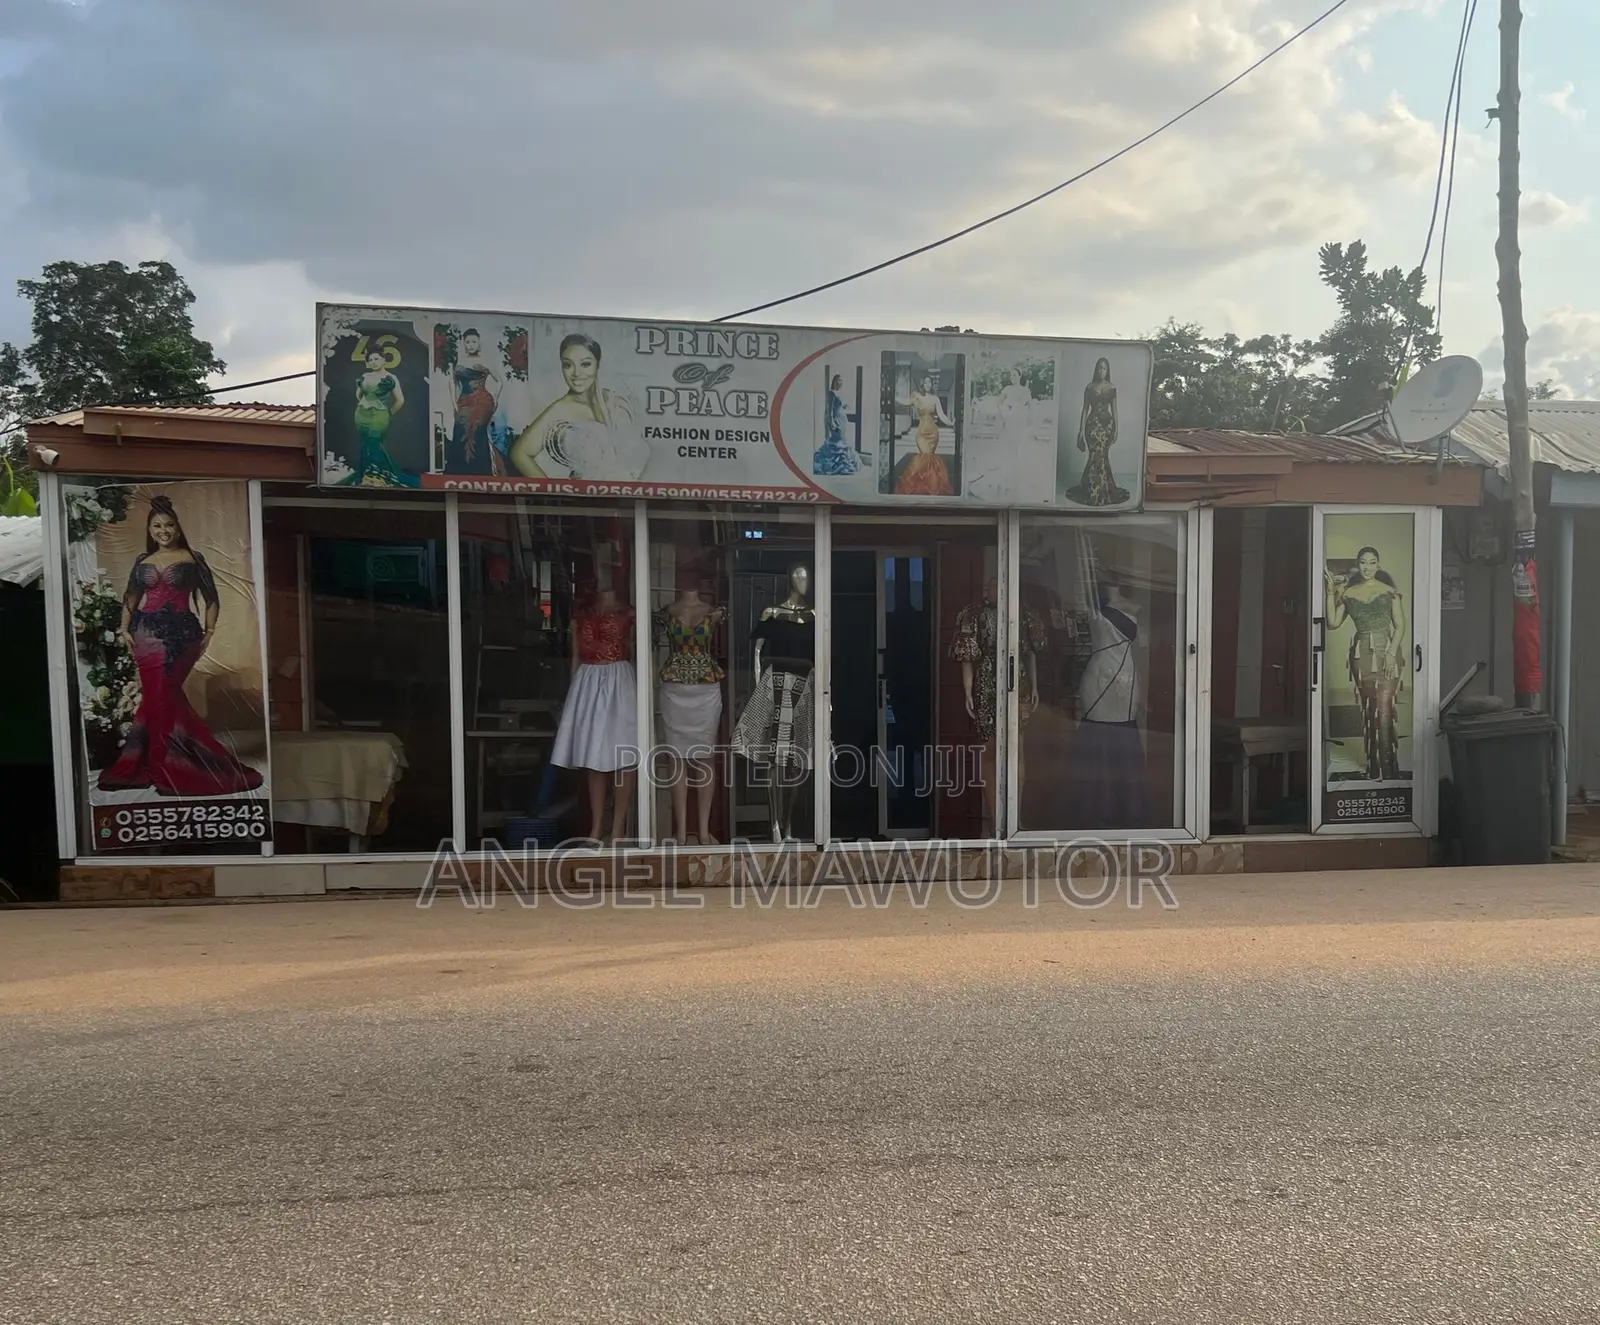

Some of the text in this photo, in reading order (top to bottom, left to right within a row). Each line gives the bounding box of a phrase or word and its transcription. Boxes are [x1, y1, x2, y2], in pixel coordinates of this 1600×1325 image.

[635, 326, 779, 360] PRINCE
[672, 363, 735, 388] Of
[646, 386, 768, 418] PEACE
[644, 426, 770, 443] FASHION DESIGN
[677, 445, 738, 460] CENTER
[444, 480, 541, 493] CONTACT
[1336, 796, 1406, 808] 0555782342
[1337, 805, 1406, 817] 0256415900
[115, 805, 265, 826] 0555782342
[117, 822, 266, 843] 0256415900
